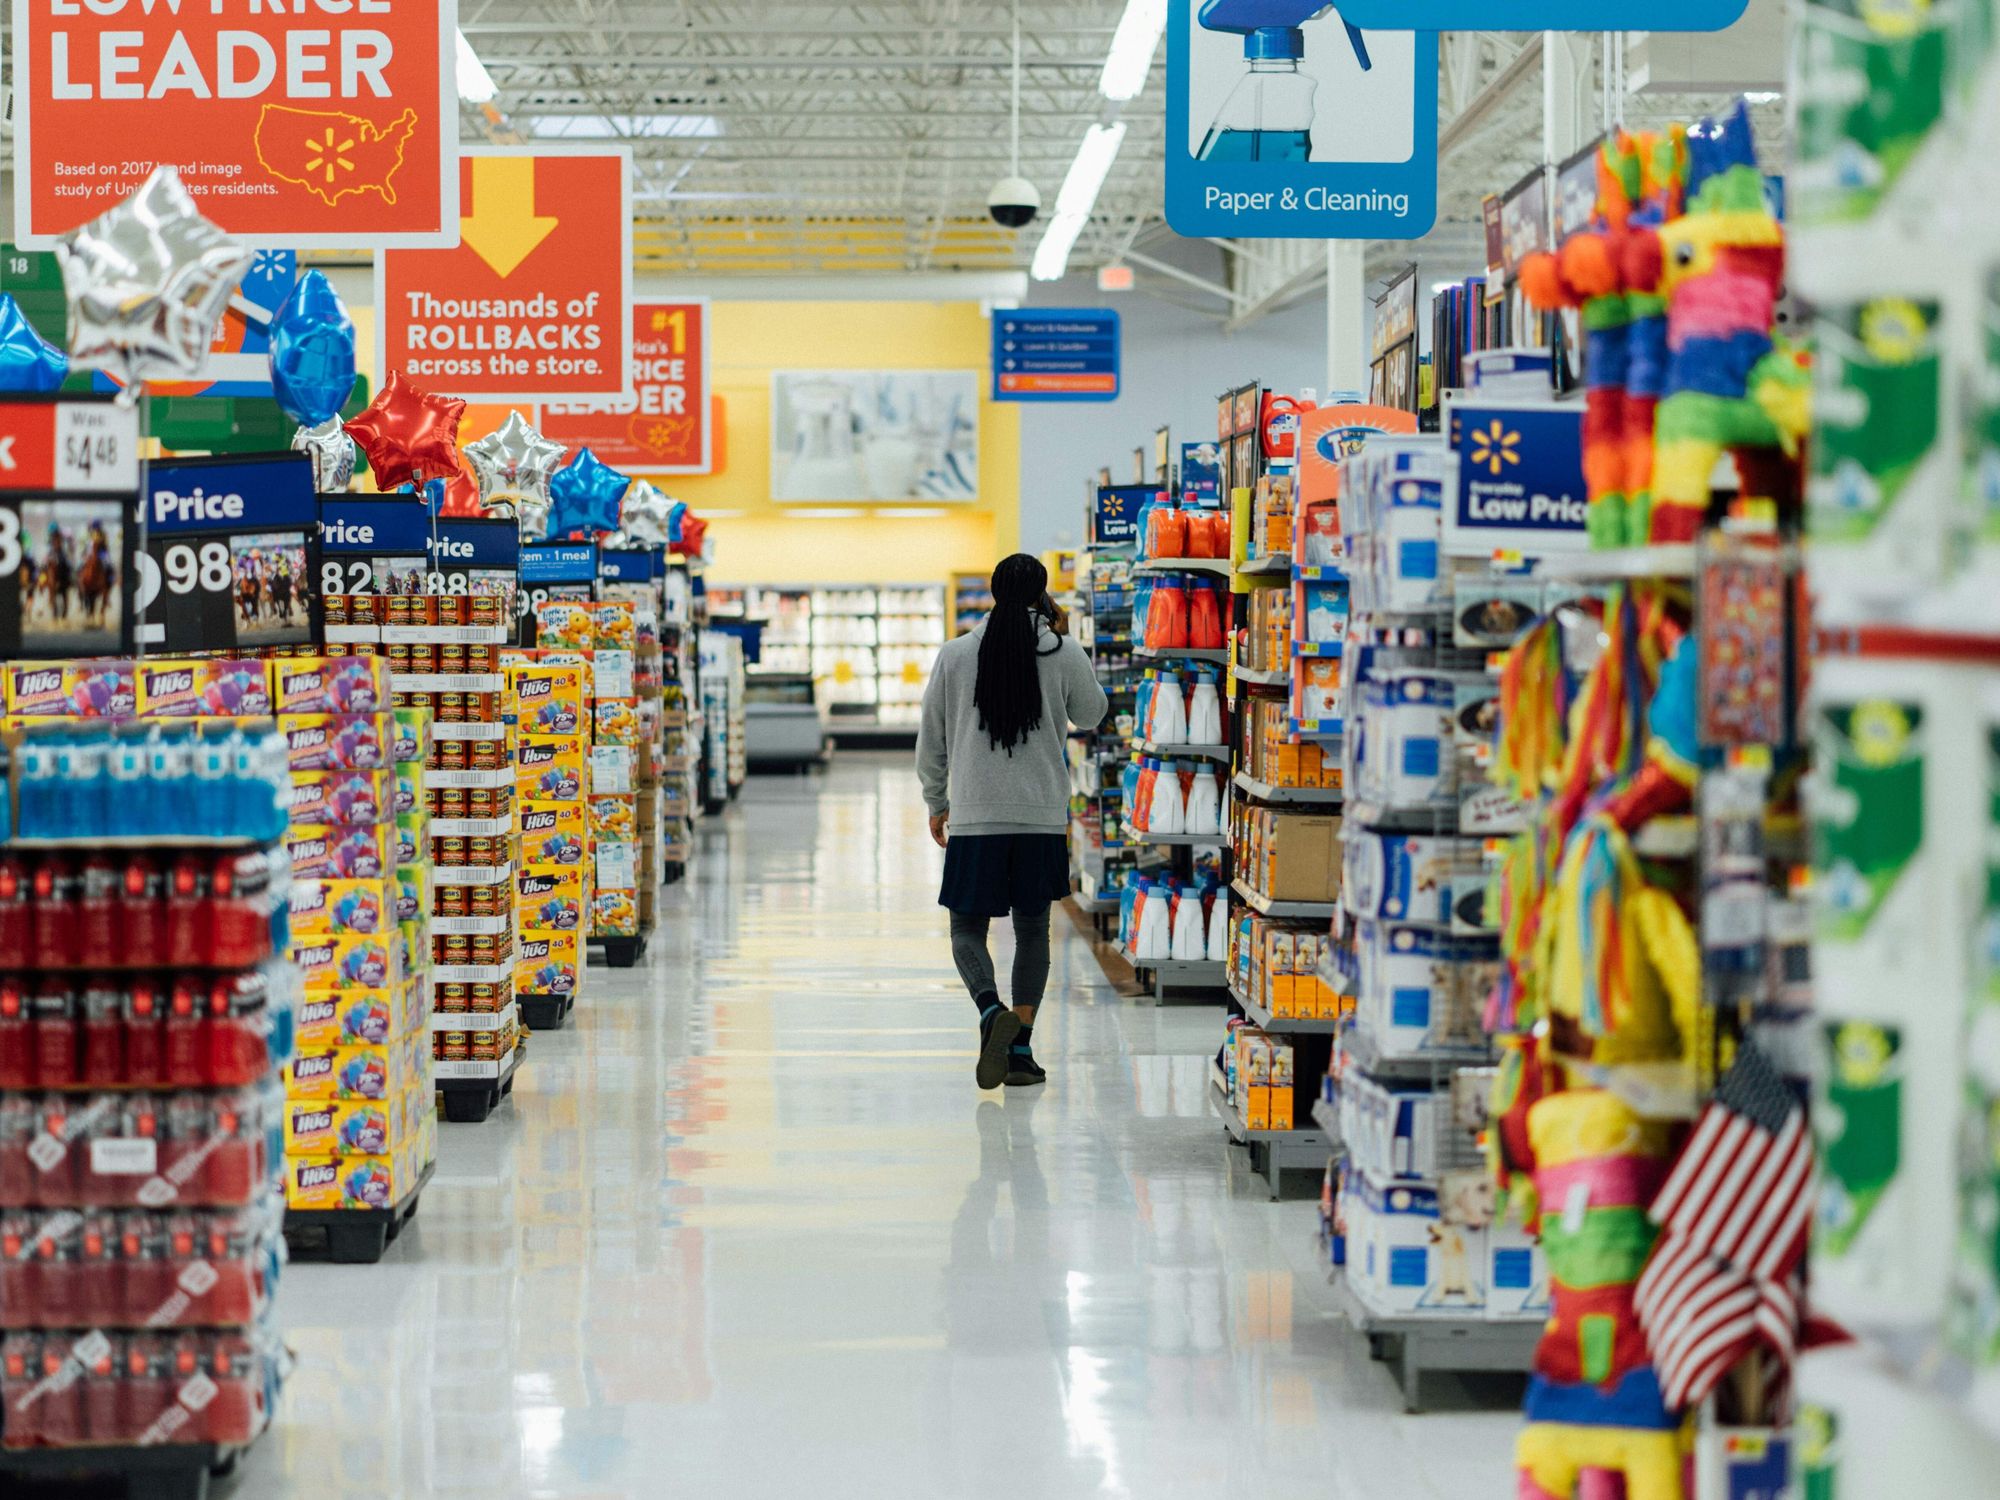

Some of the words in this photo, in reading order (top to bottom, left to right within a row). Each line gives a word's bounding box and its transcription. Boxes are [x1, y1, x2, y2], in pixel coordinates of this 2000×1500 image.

[51, 30, 393, 99] LEADER
[54, 162, 96, 175] Based
[99, 165, 117, 175] on
[121, 162, 153, 175] 2017
[201, 162, 242, 180] image
[54, 182, 92, 198] study
[96, 182, 111, 195] of
[212, 182, 279, 195] residents.
[1205, 186, 1274, 215] Paper
[1280, 187, 1298, 210] &
[1304, 187, 1409, 217] Cleaning
[9, 258, 28, 274] 18
[406, 292, 559, 318] Thousands
[566, 292, 600, 318] of
[407, 325, 601, 350] ROLLBACKS
[406, 359, 482, 375] across
[489, 356, 530, 375] the
[536, 358, 603, 376] store.
[633, 359, 685, 382] RICE
[154, 488, 244, 523] Price
[1469, 495, 1527, 520] Low
[316, 519, 374, 544] rice
[165, 542, 231, 594] 98
[321, 561, 372, 595] 82
[327, 598, 342, 606] USH'S
[21, 673, 61, 696] HUG
[152, 673, 192, 697] HUG
[288, 675, 321, 695] HUG
[521, 682, 550, 697] HUG
[554, 678, 566, 686] 40
[291, 730, 325, 749] HUG
[526, 815, 555, 830] HUG
[560, 810, 571, 818] 40
[293, 842, 325, 860] HUG
[300, 950, 331, 966] HUG
[521, 943, 547, 959] HUG
[301, 1005, 334, 1023] HUG
[297, 1057, 330, 1076] HUG
[297, 1114, 330, 1133] HUG
[302, 1167, 335, 1187] HUG
